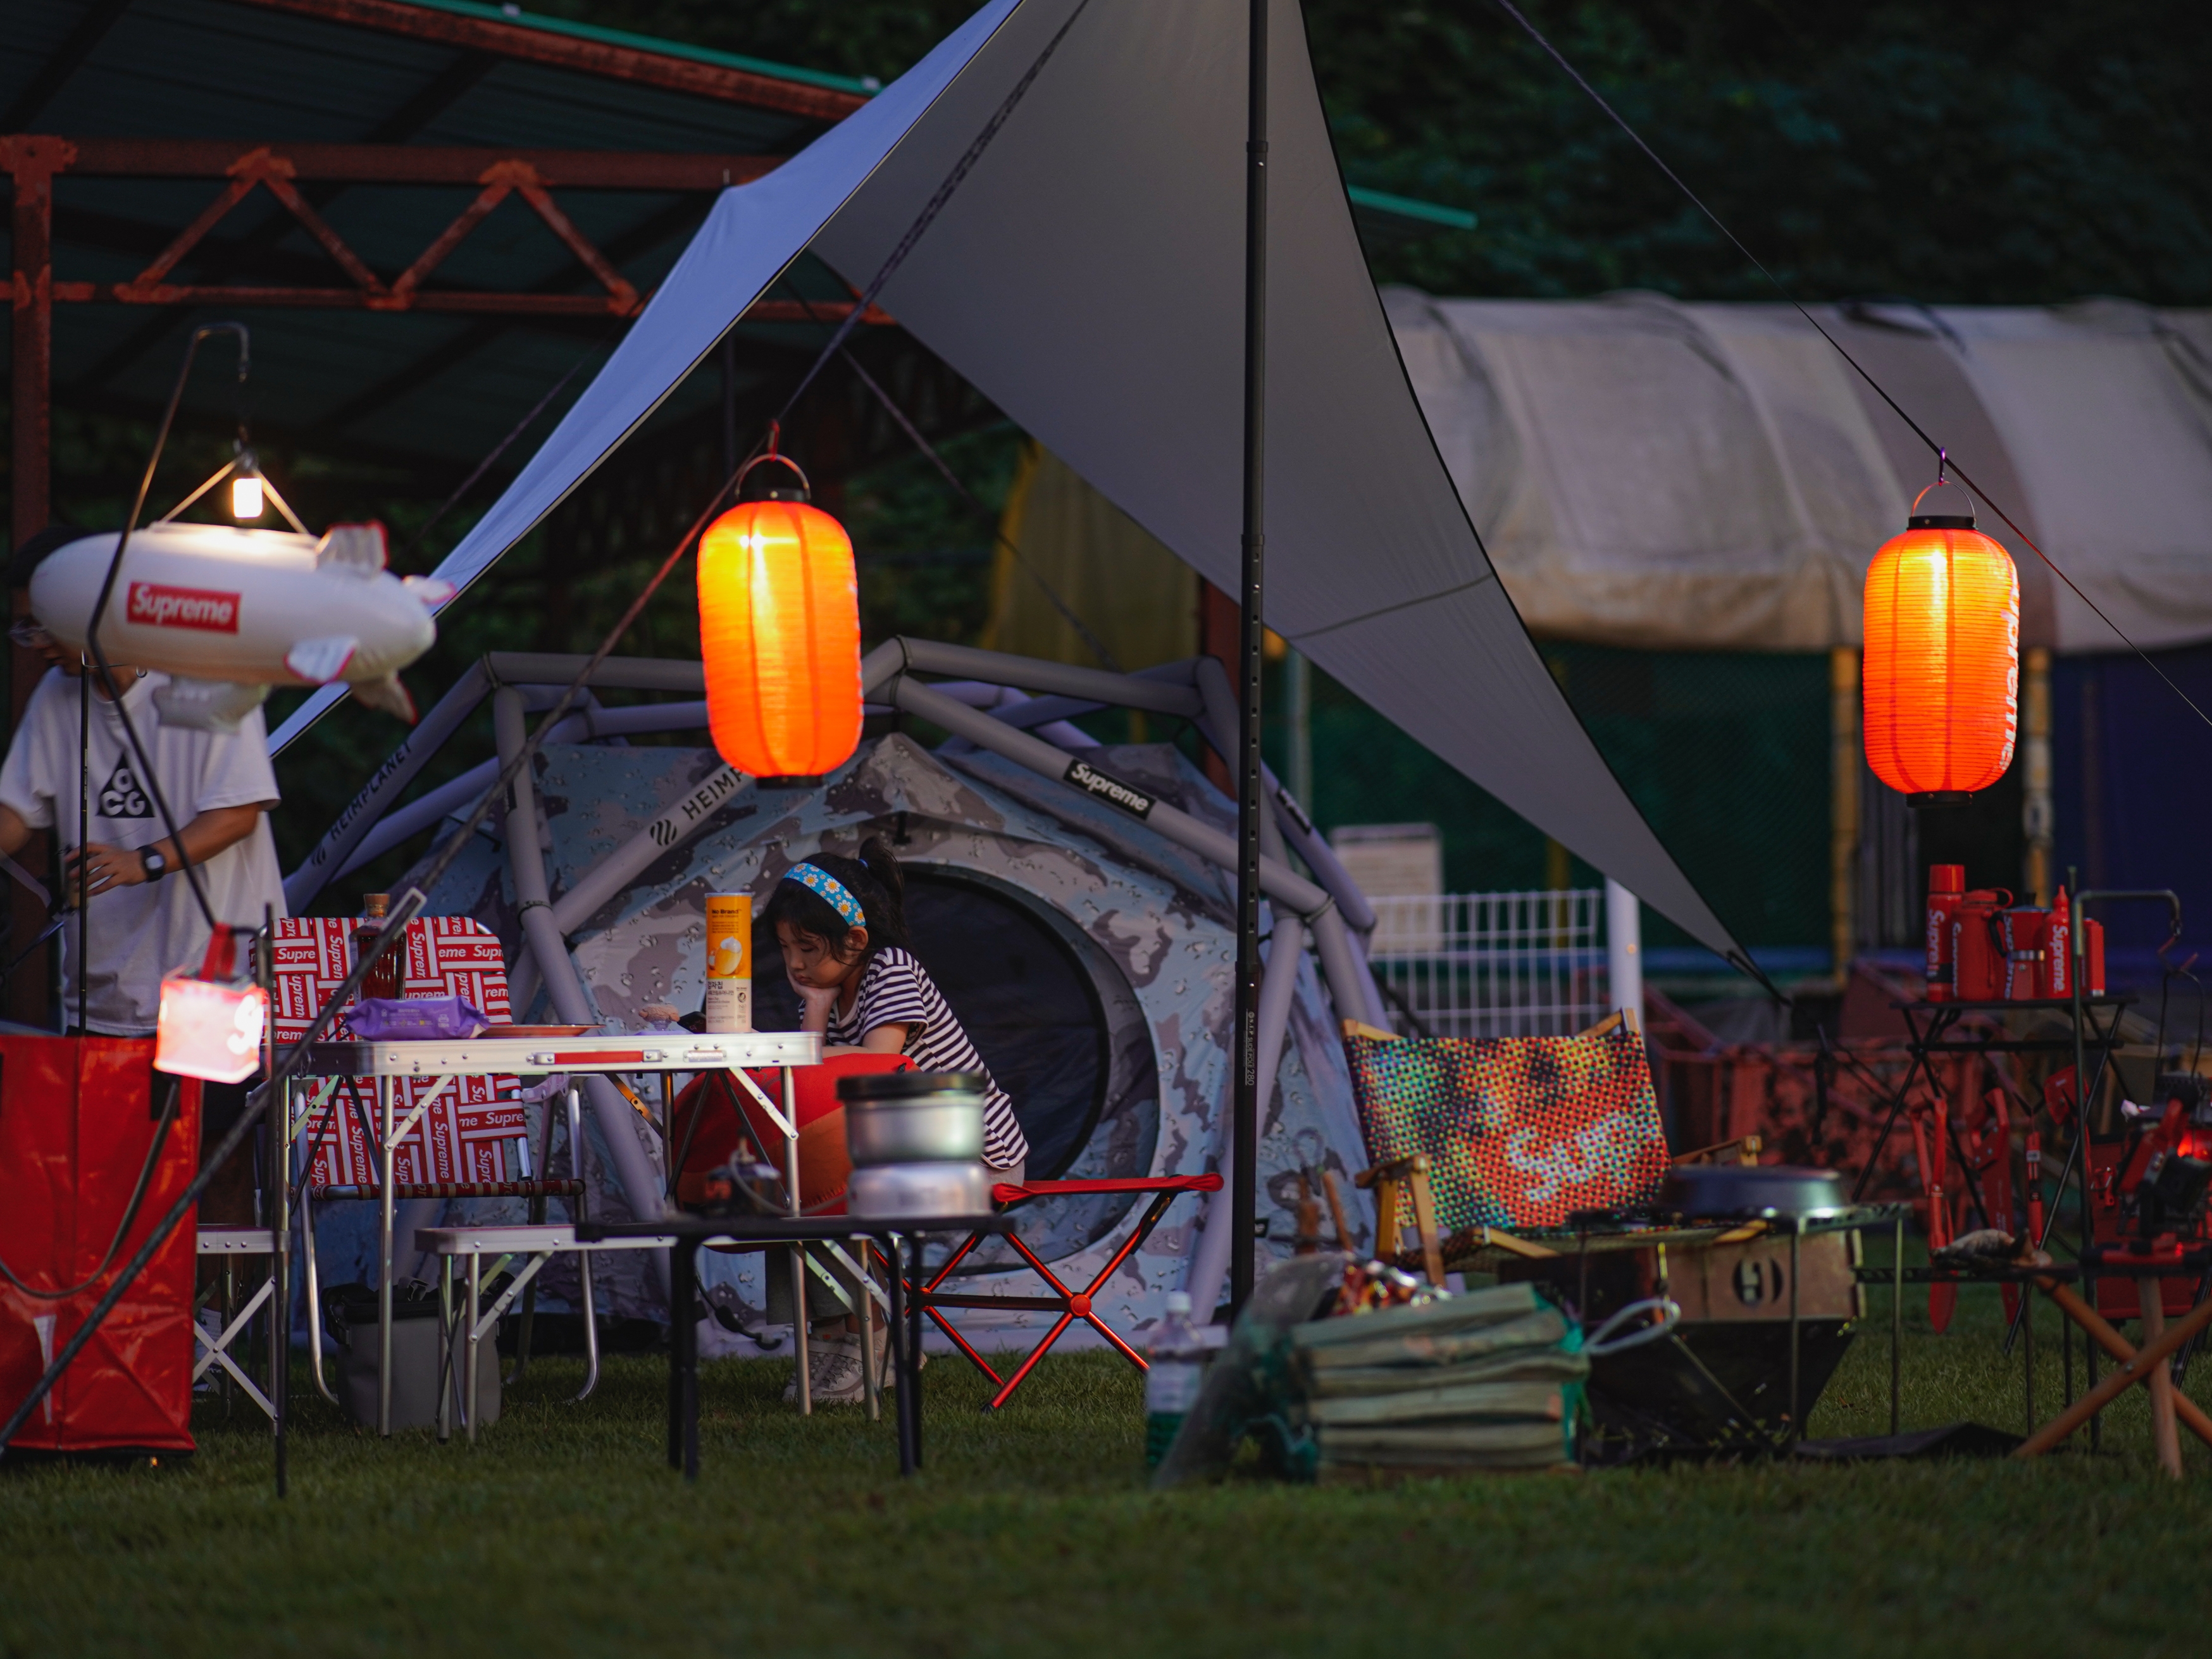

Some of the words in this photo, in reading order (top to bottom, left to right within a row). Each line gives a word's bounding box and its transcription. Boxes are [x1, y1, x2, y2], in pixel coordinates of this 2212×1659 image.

[132, 585, 233, 624] Supreme
[330, 742, 411, 841] HEIMPLANET
[1071, 762, 1149, 811] Supreme
[277, 948, 316, 963] Supre
[438, 948, 466, 958] eme
[473, 945, 504, 960] Supr
[2004, 915, 2015, 999] Supeme
[2049, 924, 2068, 991] Supreme
[289, 974, 305, 1018] uprem
[469, 1084, 485, 1103] Su
[485, 1111, 524, 1128] Supre
[349, 1126, 368, 1183] Supreme
[432, 1121, 450, 1179] Supreme
